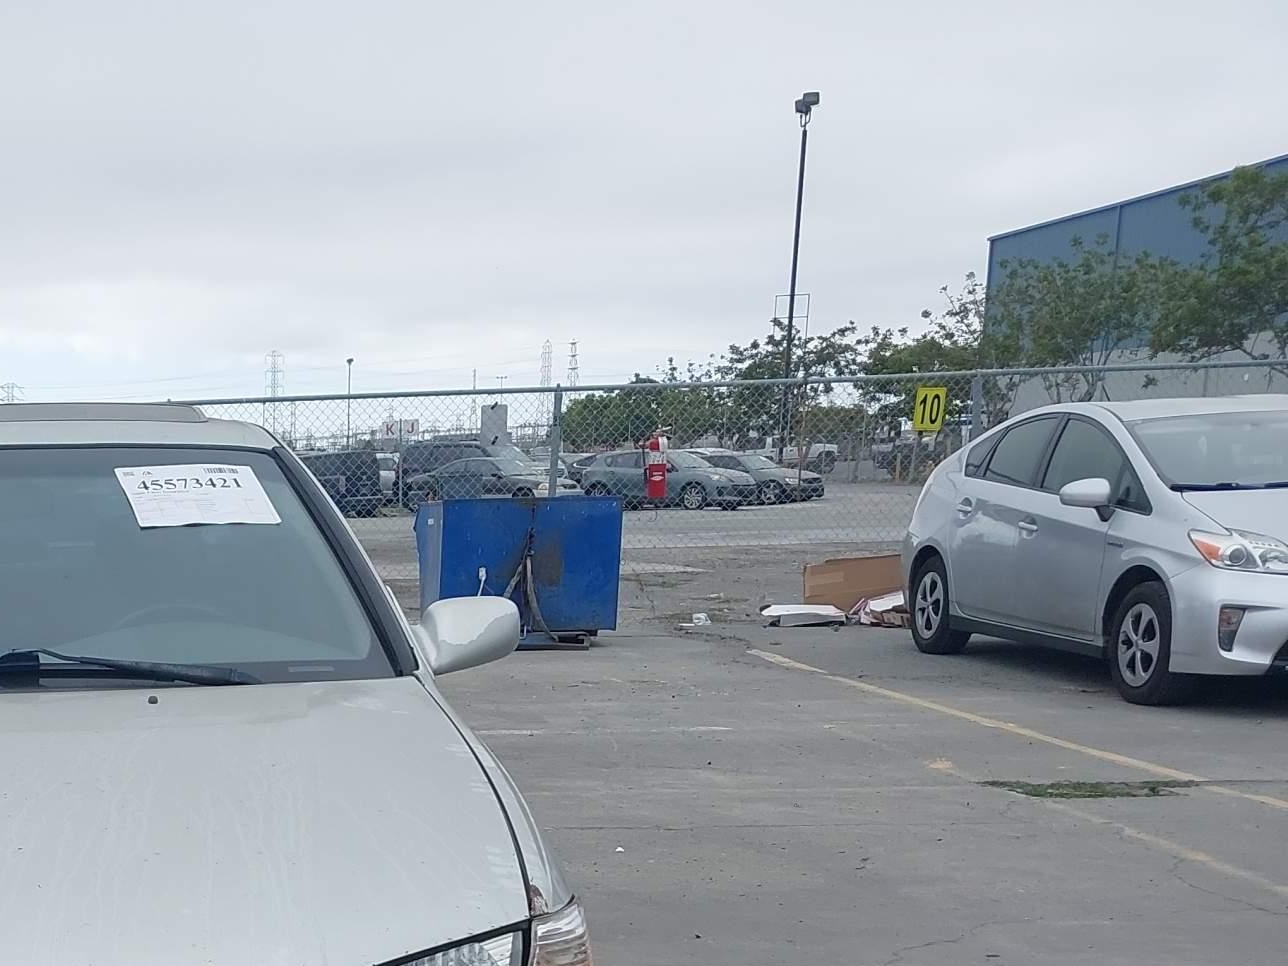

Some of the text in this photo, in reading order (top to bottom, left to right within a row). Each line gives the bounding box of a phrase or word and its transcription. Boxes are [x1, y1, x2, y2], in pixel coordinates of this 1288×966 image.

[919, 393, 941, 425] 10
[385, 423, 395, 436] K
[407, 422, 415, 434] J
[137, 477, 244, 491] 45573421
